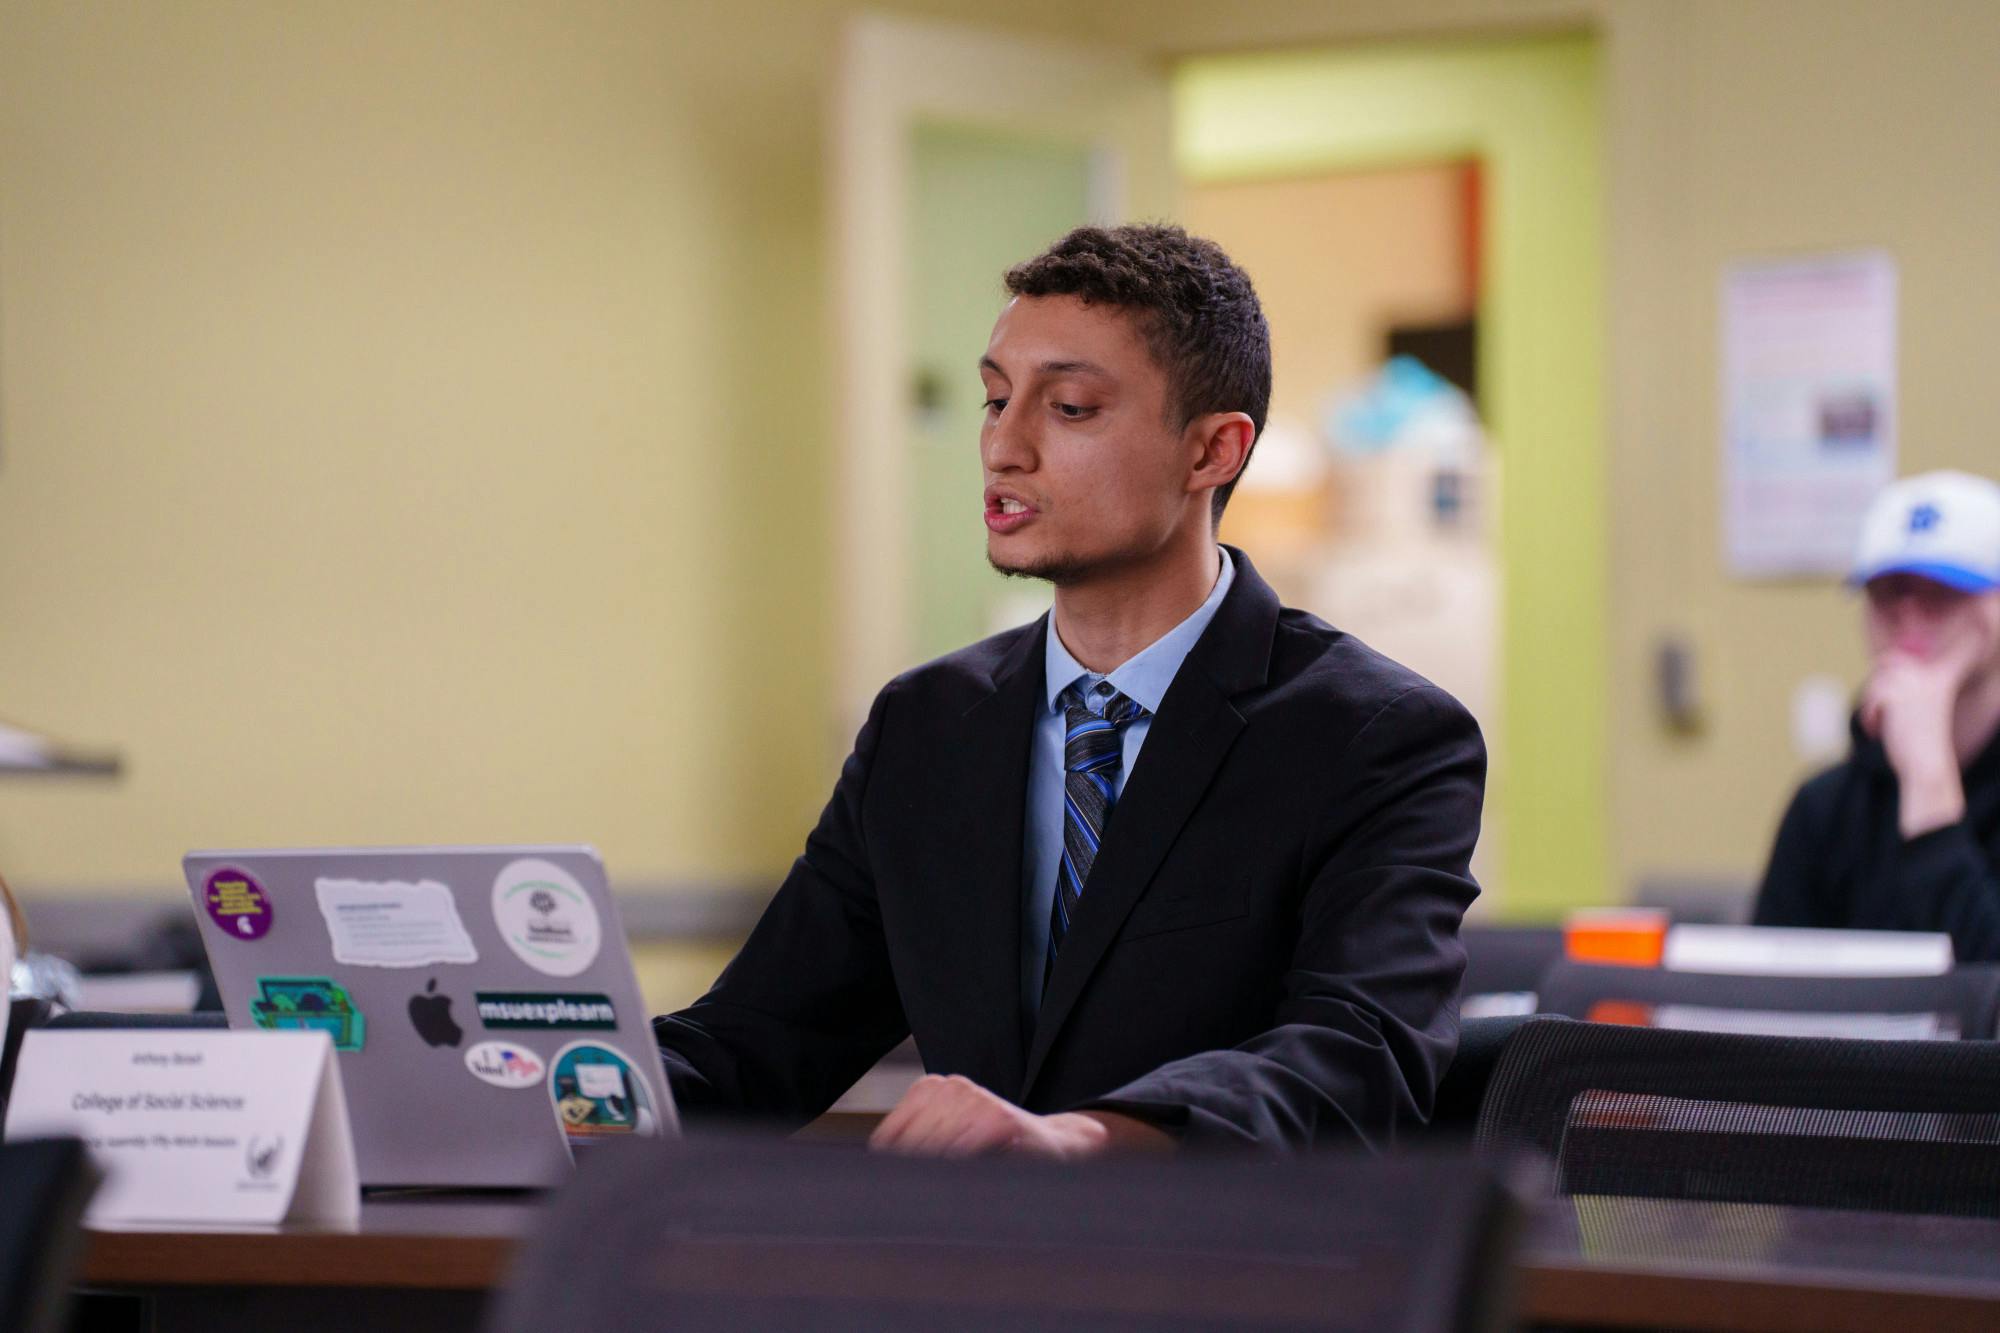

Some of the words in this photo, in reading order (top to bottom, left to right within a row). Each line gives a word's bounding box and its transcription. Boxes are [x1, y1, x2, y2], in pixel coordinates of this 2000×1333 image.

[479, 999, 613, 1024] msuexplearn
[72, 1093, 123, 1114] College
[127, 1092, 142, 1109] of
[145, 1093, 184, 1110] Social
[190, 1093, 243, 1110] Science
